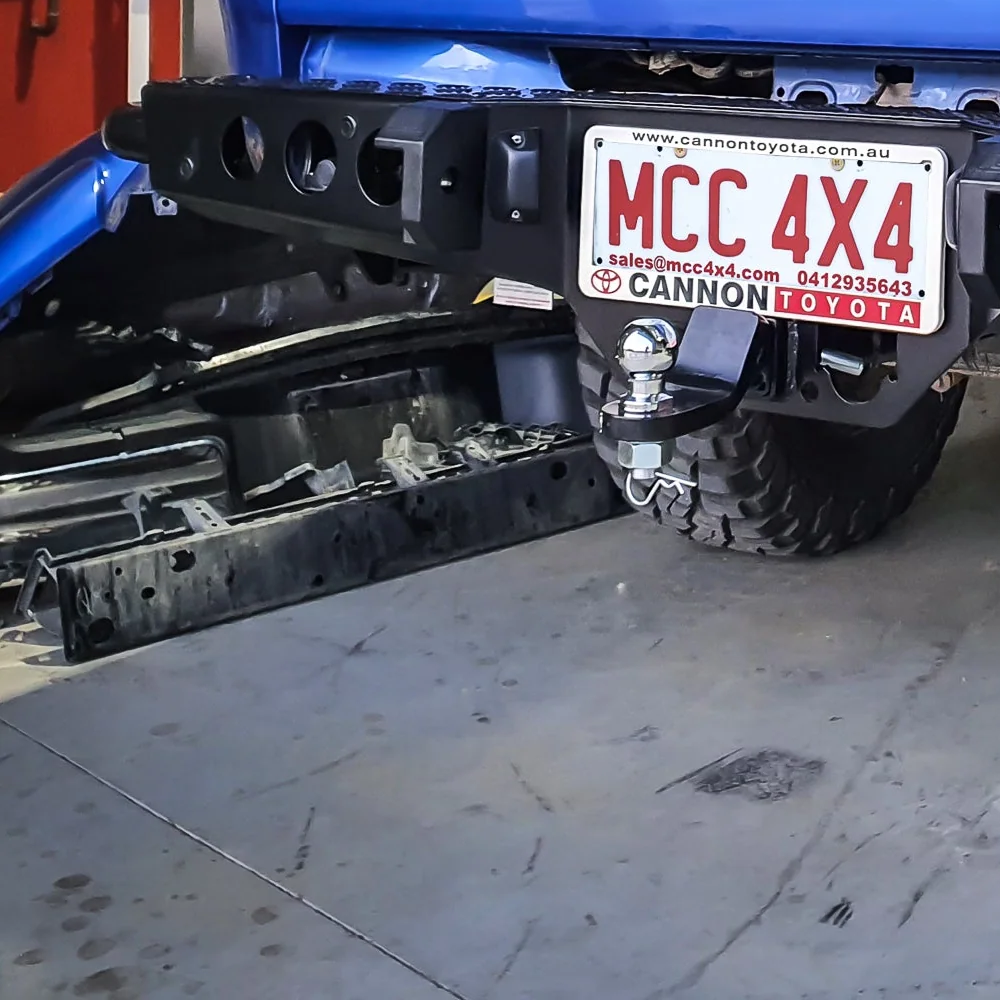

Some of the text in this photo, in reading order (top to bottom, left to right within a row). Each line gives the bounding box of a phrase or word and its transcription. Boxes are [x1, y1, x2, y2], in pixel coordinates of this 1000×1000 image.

[632, 131, 890, 159] www.cannontoyota.com.au
[608, 159, 914, 274] MCC 4X4
[608, 252, 912, 297] sales@mcc4x4.com 0412935643
[628, 272, 915, 324] CANNON TOYOTA
